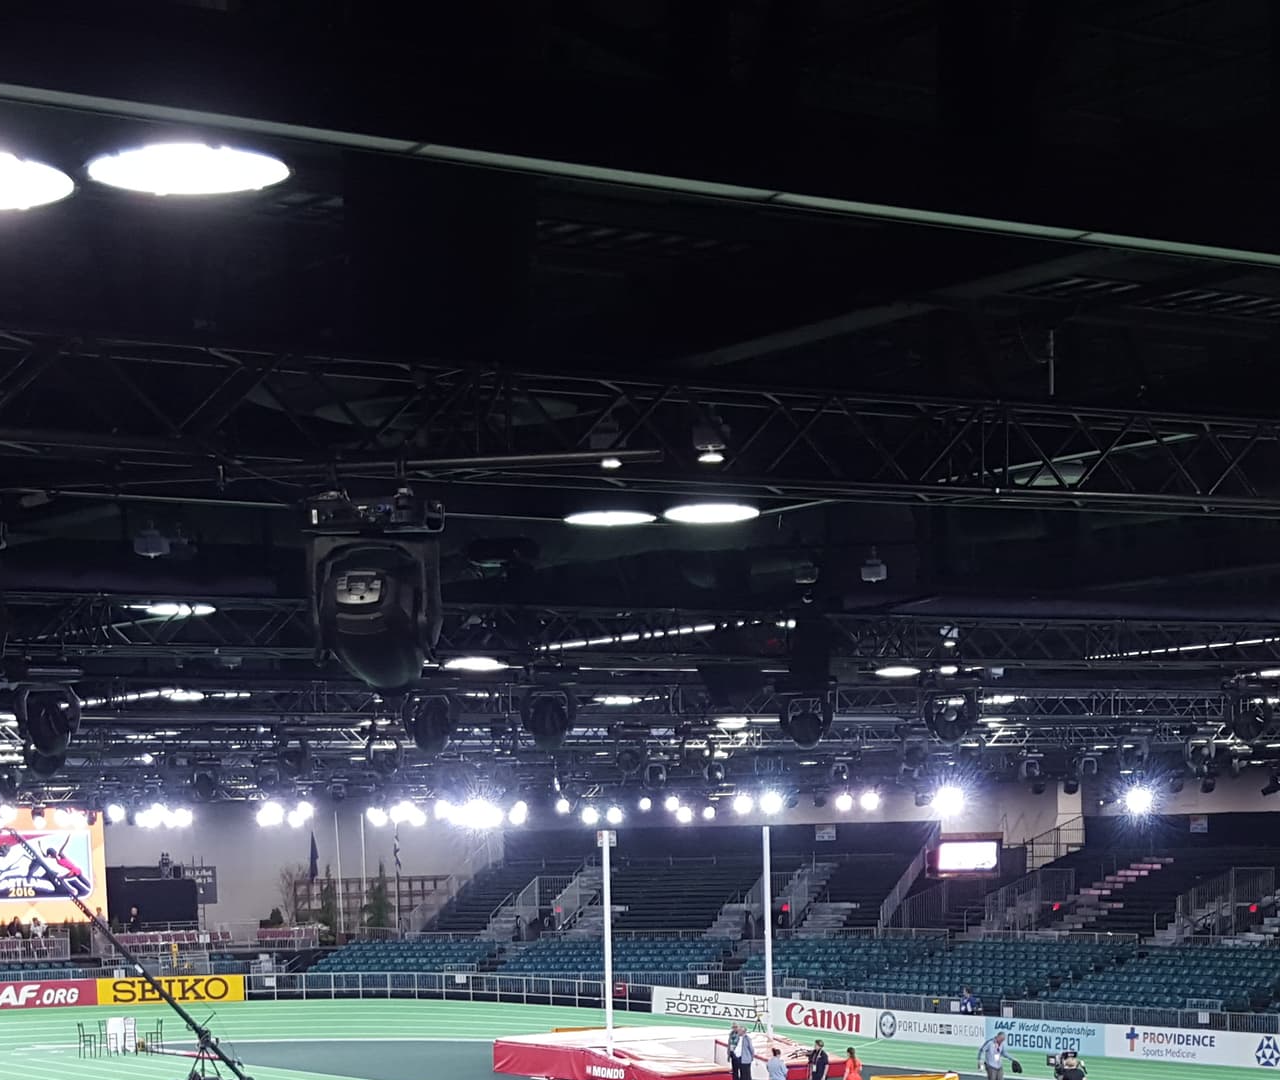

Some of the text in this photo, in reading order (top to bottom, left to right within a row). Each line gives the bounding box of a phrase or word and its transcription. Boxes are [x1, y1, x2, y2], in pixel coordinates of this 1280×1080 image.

[8, 887, 35, 897] 2016
[112, 977, 229, 1003] SEIKO
[678, 991, 720, 1004] travel
[666, 1000, 758, 1020] PORTLAND
[785, 1002, 861, 1033] Canon
[897, 1022, 938, 1034] PORTLAND
[953, 1023, 985, 1037] OREGON
[994, 1020, 1096, 1037] IAAF World Championships
[1007, 1033, 1081, 1051] OREGON 2021
[1142, 1031, 1216, 1048] PROVIDENCE
[1142, 1046, 1197, 1059] Sports Medicine
[592, 1065, 625, 1079] MONDO
